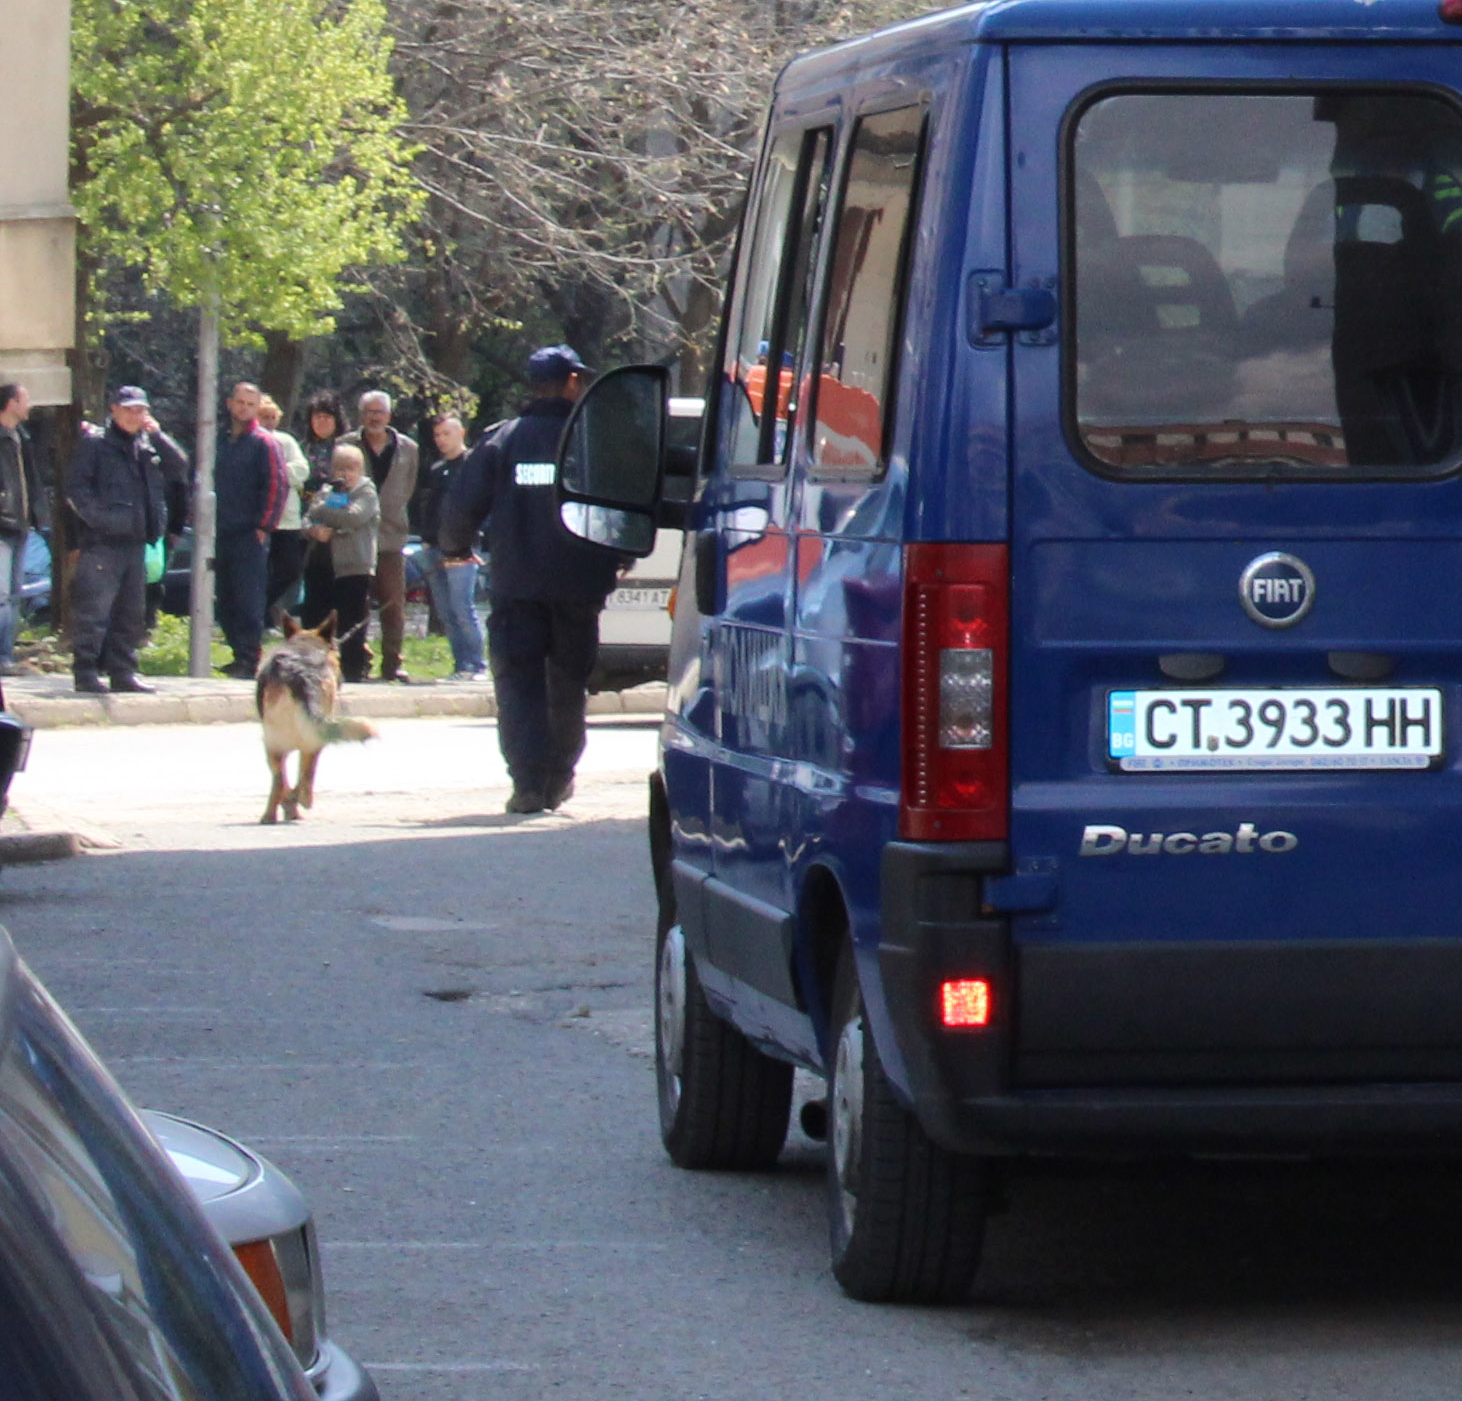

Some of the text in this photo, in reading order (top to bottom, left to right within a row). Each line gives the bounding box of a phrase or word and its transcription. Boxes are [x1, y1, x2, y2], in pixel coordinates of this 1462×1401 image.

[514, 462, 556, 486] SECURIT
[1253, 578, 1303, 603] FIAT
[1112, 732, 1134, 748] BG
[1079, 822, 1298, 856] Ducato
